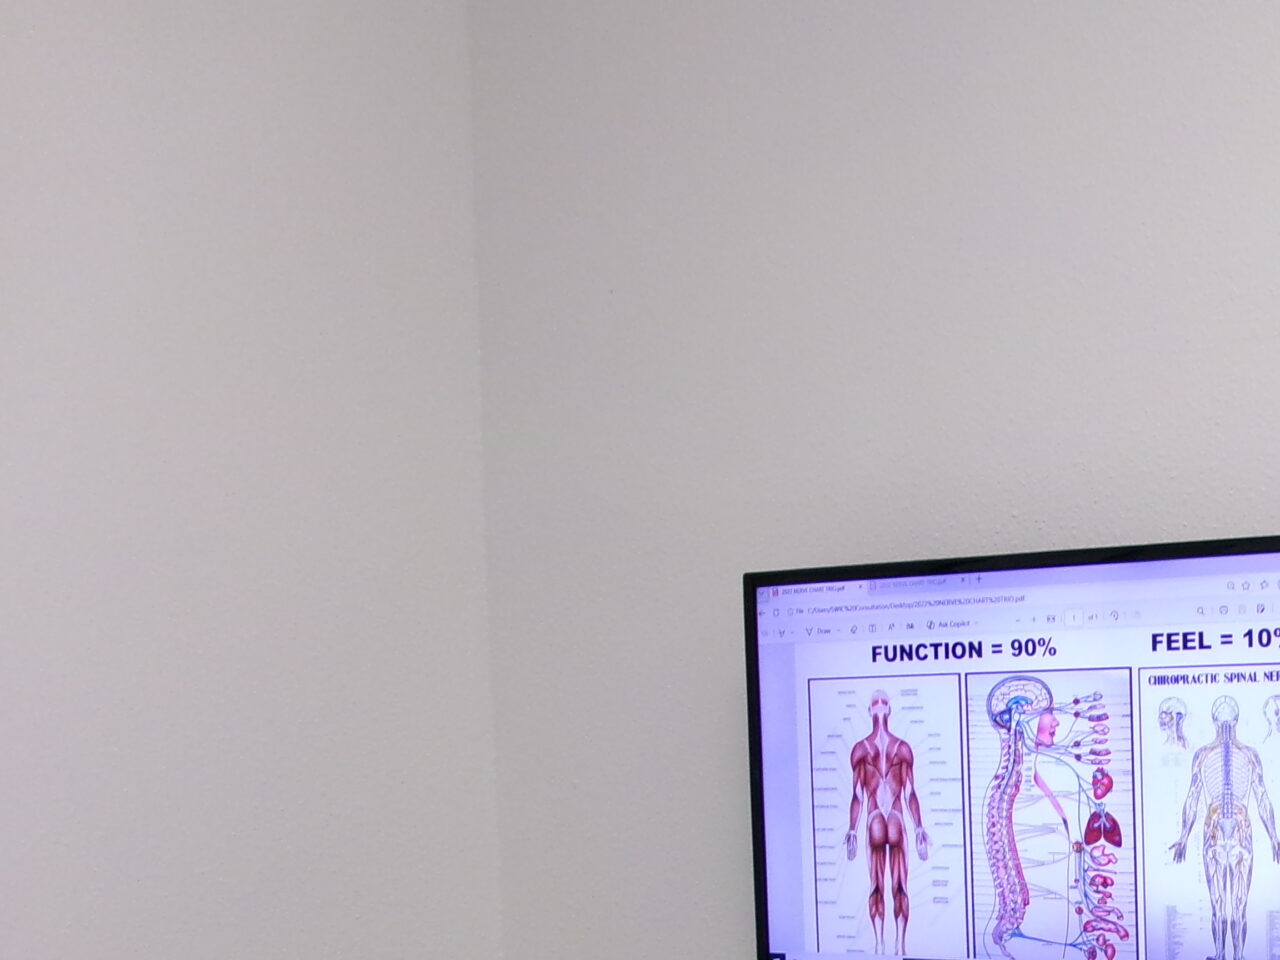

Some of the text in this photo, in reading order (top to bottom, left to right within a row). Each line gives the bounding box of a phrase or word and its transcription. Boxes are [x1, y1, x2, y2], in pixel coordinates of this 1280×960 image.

[872, 637, 1056, 662] FUNCTION = 90%
[1152, 631, 1212, 651] FEEL
[1221, 634, 1233, 644] =
[1148, 672, 1220, 686] CHIROPRACTIC
[1224, 671, 1259, 683] SPINAL
